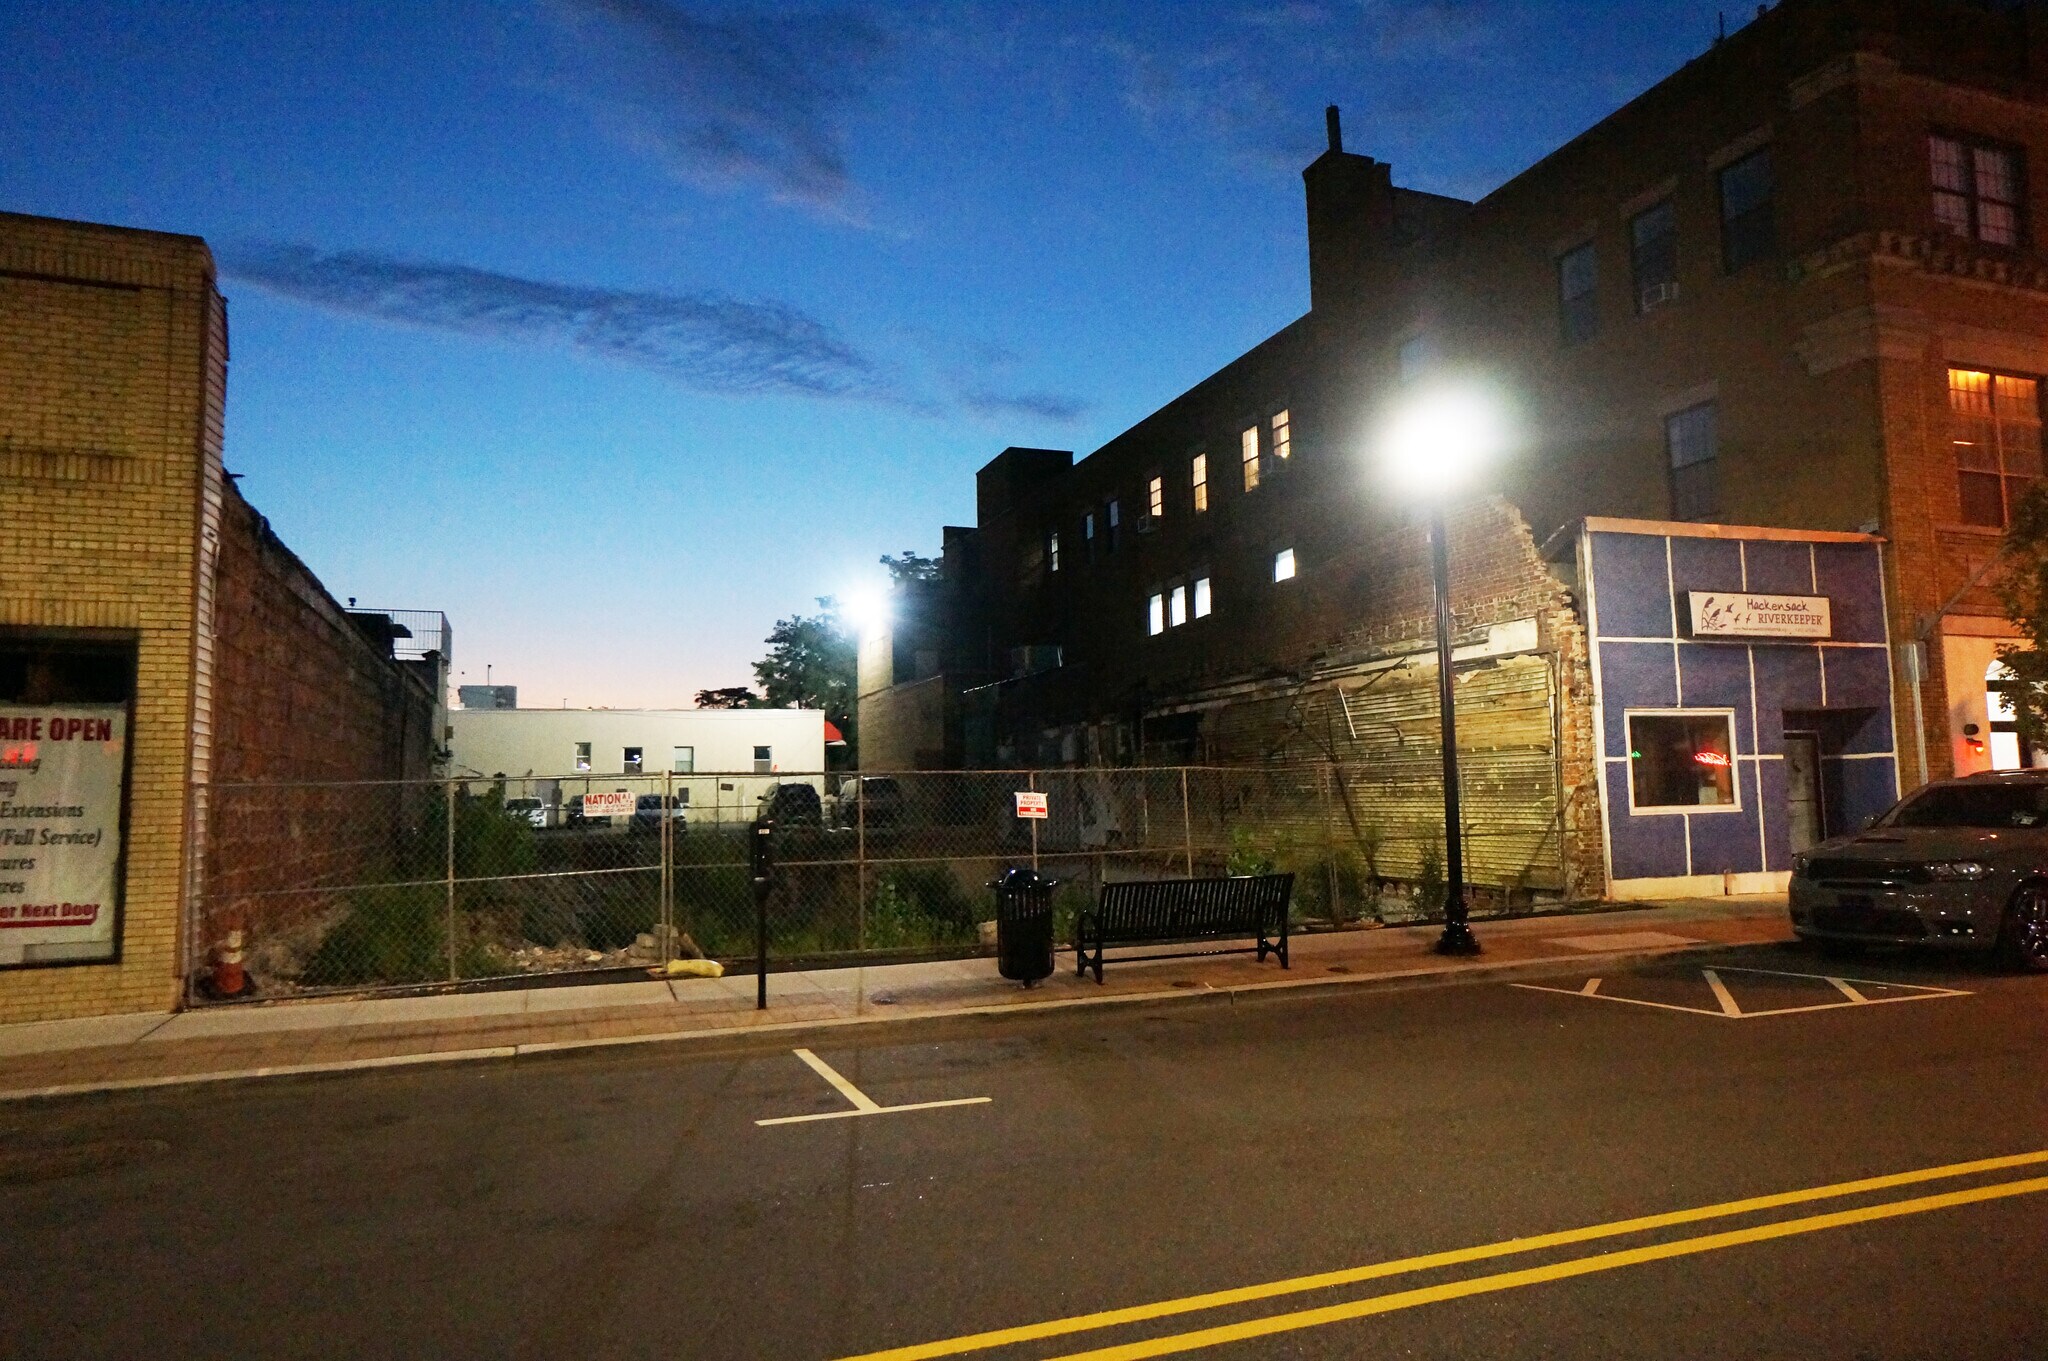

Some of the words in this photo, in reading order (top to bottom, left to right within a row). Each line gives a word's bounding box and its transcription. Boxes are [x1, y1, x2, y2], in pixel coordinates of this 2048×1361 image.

[1746, 598, 1809, 611] Hackensack
[1757, 613, 1823, 625] RIVERKEEPER
[0, 717, 42, 740] ARE
[49, 717, 111, 741] OPEN
[0, 801, 84, 818] Extensions
[40, 828, 101, 847] Service)
[21, 903, 58, 918] Next
[61, 902, 100, 919] Door
